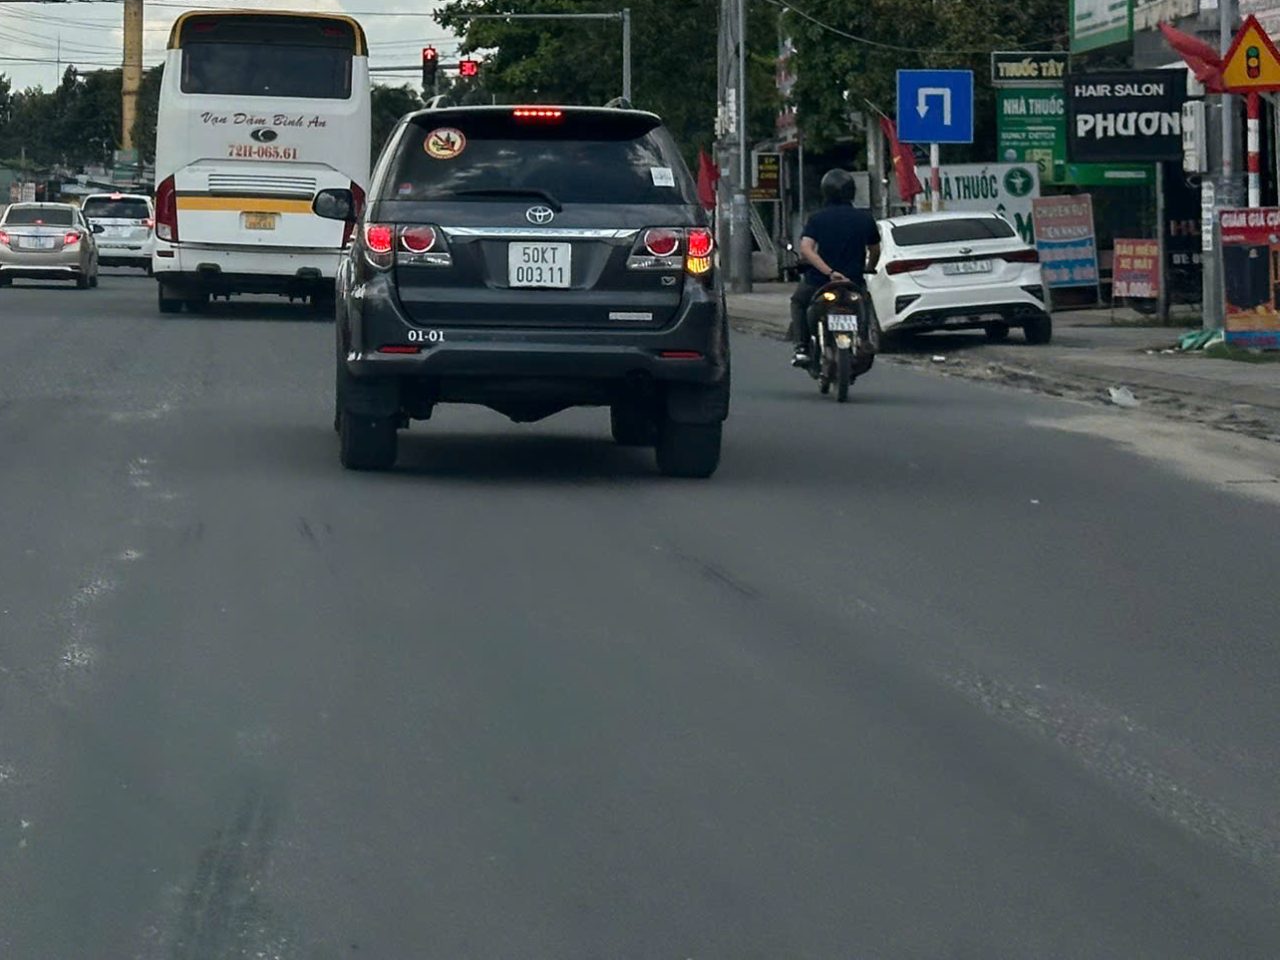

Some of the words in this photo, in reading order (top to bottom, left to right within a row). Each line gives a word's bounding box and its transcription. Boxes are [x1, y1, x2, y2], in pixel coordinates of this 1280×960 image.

[1040, 58, 1064, 77] TÂY
[1075, 85, 1111, 97] HAIR
[1114, 83, 1164, 96] SALON
[1003, 95, 1026, 115] NHÀ
[1028, 94, 1064, 115] THUỐC
[307, 115, 328, 128] An
[228, 144, 297, 159] 72H-065.61
[924, 171, 953, 200] NÀ
[955, 167, 998, 200] THUỐC
[522, 247, 559, 264] 50KT
[516, 266, 564, 284] 003.11
[407, 330, 445, 342] 01-01
